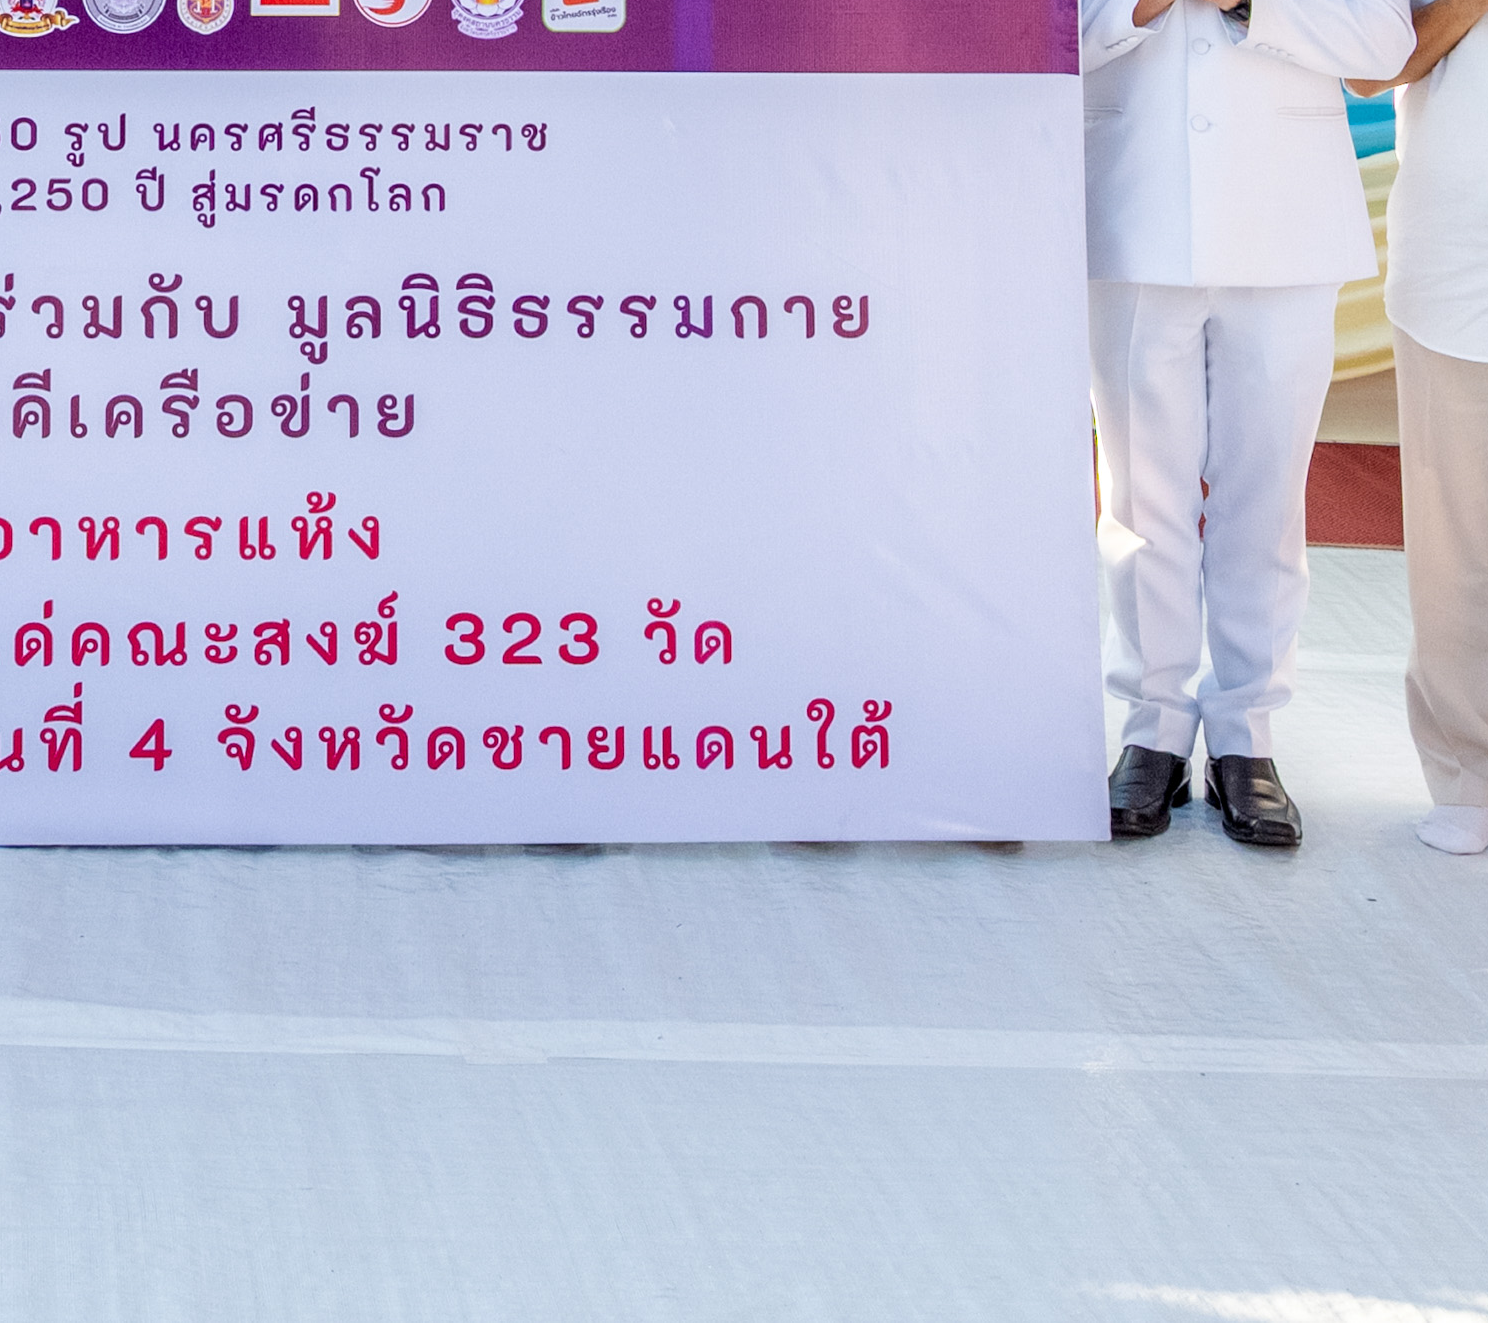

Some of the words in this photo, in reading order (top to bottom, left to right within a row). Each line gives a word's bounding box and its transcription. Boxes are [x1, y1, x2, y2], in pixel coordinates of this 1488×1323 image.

[63, 112, 127, 166] รูป
[152, 106, 548, 152] นครศรีธรรมราช
[134, 166, 165, 213] ปี
[191, 167, 446, 229] สู่มรดกโลก
[287, 273, 870, 365] มูลนิธิธรรมกาย
[443, 611, 600, 666] 323
[643, 598, 733, 666] วัด
[128, 717, 173, 773] 4
[216, 697, 893, 772] จังหวัดชายแดนใต้
